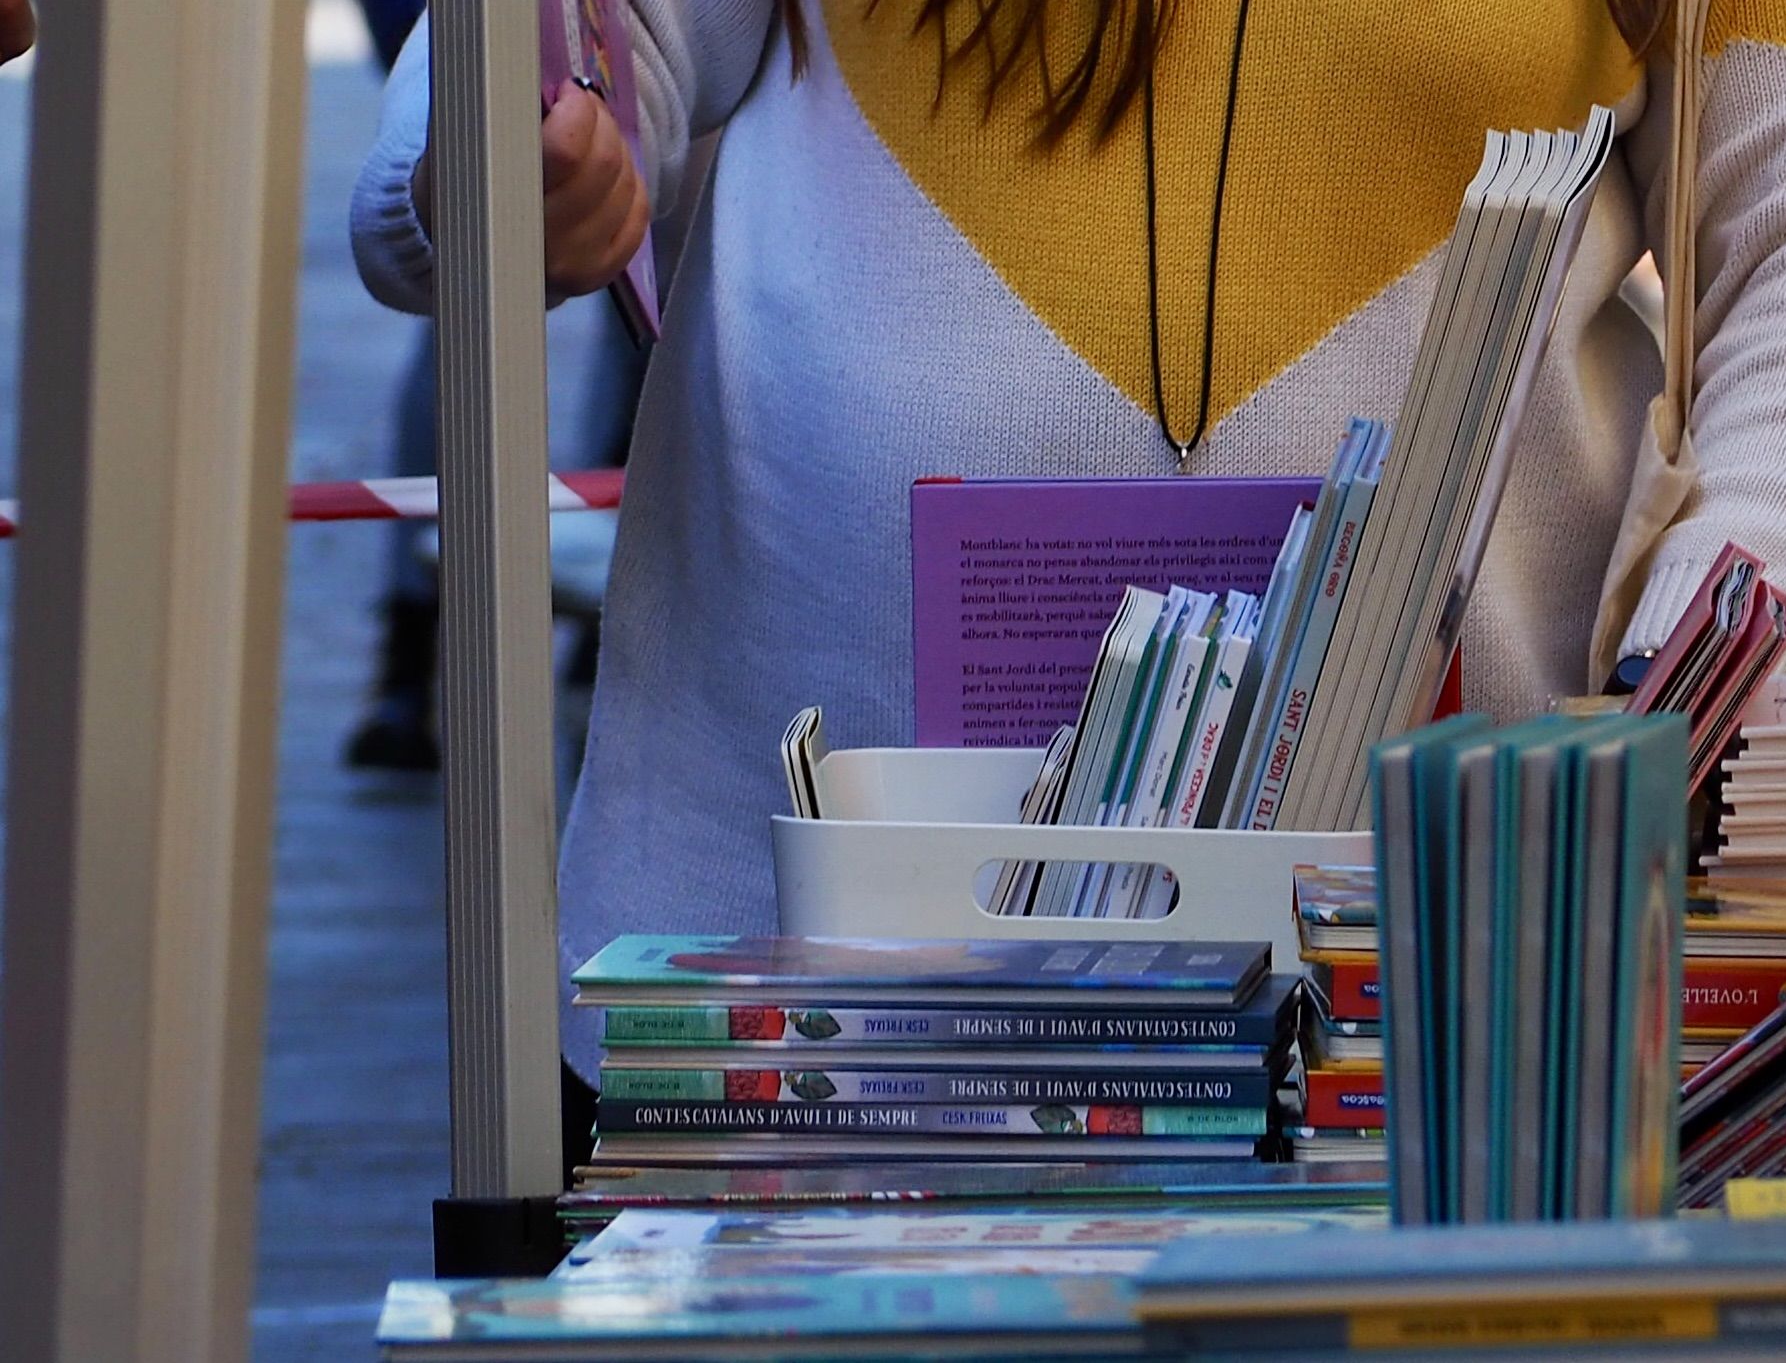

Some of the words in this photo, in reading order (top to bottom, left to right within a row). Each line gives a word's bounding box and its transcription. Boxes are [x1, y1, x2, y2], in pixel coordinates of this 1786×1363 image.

[960, 538, 1022, 551] Montblanc
[1026, 537, 1040, 550] ha
[1043, 538, 1074, 550] votat:
[1078, 539, 1092, 549] no
[1095, 537, 1112, 549] vol
[1115, 537, 1144, 549] viure
[1148, 536, 1171, 548] més
[1174, 537, 1197, 547] sota
[1200, 536, 1216, 547] les
[1219, 536, 1256, 547] ordres
[1333, 521, 1356, 568] BEGOÑA
[960, 556, 971, 568] el
[974, 559, 1024, 568] monarca
[1027, 558, 1041, 568] no
[1044, 558, 1077, 570] pensa
[1080, 555, 1141, 567] abandonar
[1144, 555, 1160, 565] els
[1163, 554, 1216, 568] privilegis
[1243, 556, 1268, 565] com
[1014, 573, 1025, 585] el
[1028, 574, 1056, 585] Drac
[1058, 573, 1102, 586] Mercat,
[1105, 572, 1158, 586] despietat
[1205, 574, 1217, 583] ve
[1220, 572, 1231, 582] al
[1234, 574, 1253, 583] seu
[1325, 572, 1340, 597] ORO
[961, 593, 996, 604] ànima
[999, 591, 1029, 603] lliure
[1037, 590, 1103, 603] consciència
[961, 614, 973, 622] es
[976, 609, 1043, 622] mobilitzarà,
[1046, 609, 1085, 623] perquè
[961, 628, 1000, 639] alhora.
[1003, 628, 1020, 638] No
[1022, 630, 1078, 641] esperaran
[962, 664, 974, 675] El
[978, 664, 1002, 675] Sant
[1005, 663, 1036, 675] Jordi
[1039, 662, 1056, 674] del
[962, 684, 981, 696] per
[985, 683, 995, 693] la
[998, 681, 1045, 693] voluntat
[962, 701, 1034, 713] compartides
[1283, 688, 1307, 732] SANT
[963, 719, 1006, 729] animen
[963, 735, 1021, 746] reivindica
[1267, 734, 1293, 781] JORDI
[1256, 798, 1275, 816] EL
[906, 1019, 929, 1032] CESK
[953, 1019, 1011, 1035] SEMPRE
[1017, 1019, 1033, 1034] DE
[1039, 1019, 1045, 1034] I
[1052, 1019, 1100, 1035] D'AVUI
[1107, 1020, 1178, 1035] CATALANS
[1181, 1020, 1235, 1036] CONTES
[901, 1081, 925, 1094] CESK
[949, 1080, 1007, 1096] SEMPRE
[1012, 1081, 1029, 1096] DE
[1035, 1081, 1041, 1096] I
[1047, 1081, 1096, 1097] D'AVUI
[1103, 1081, 1174, 1097] CATALANS
[1177, 1082, 1231, 1098] CONTES
[635, 1108, 690, 1124] CONTES
[692, 1108, 764, 1124] CATALANS
[770, 1108, 820, 1125] D'AVUI
[826, 1109, 832, 1125] I
[838, 1109, 855, 1125] DE
[860, 1109, 919, 1126] SEMPRE
[942, 1112, 966, 1125] CESK
[969, 1112, 1008, 1125] FREIXAS
